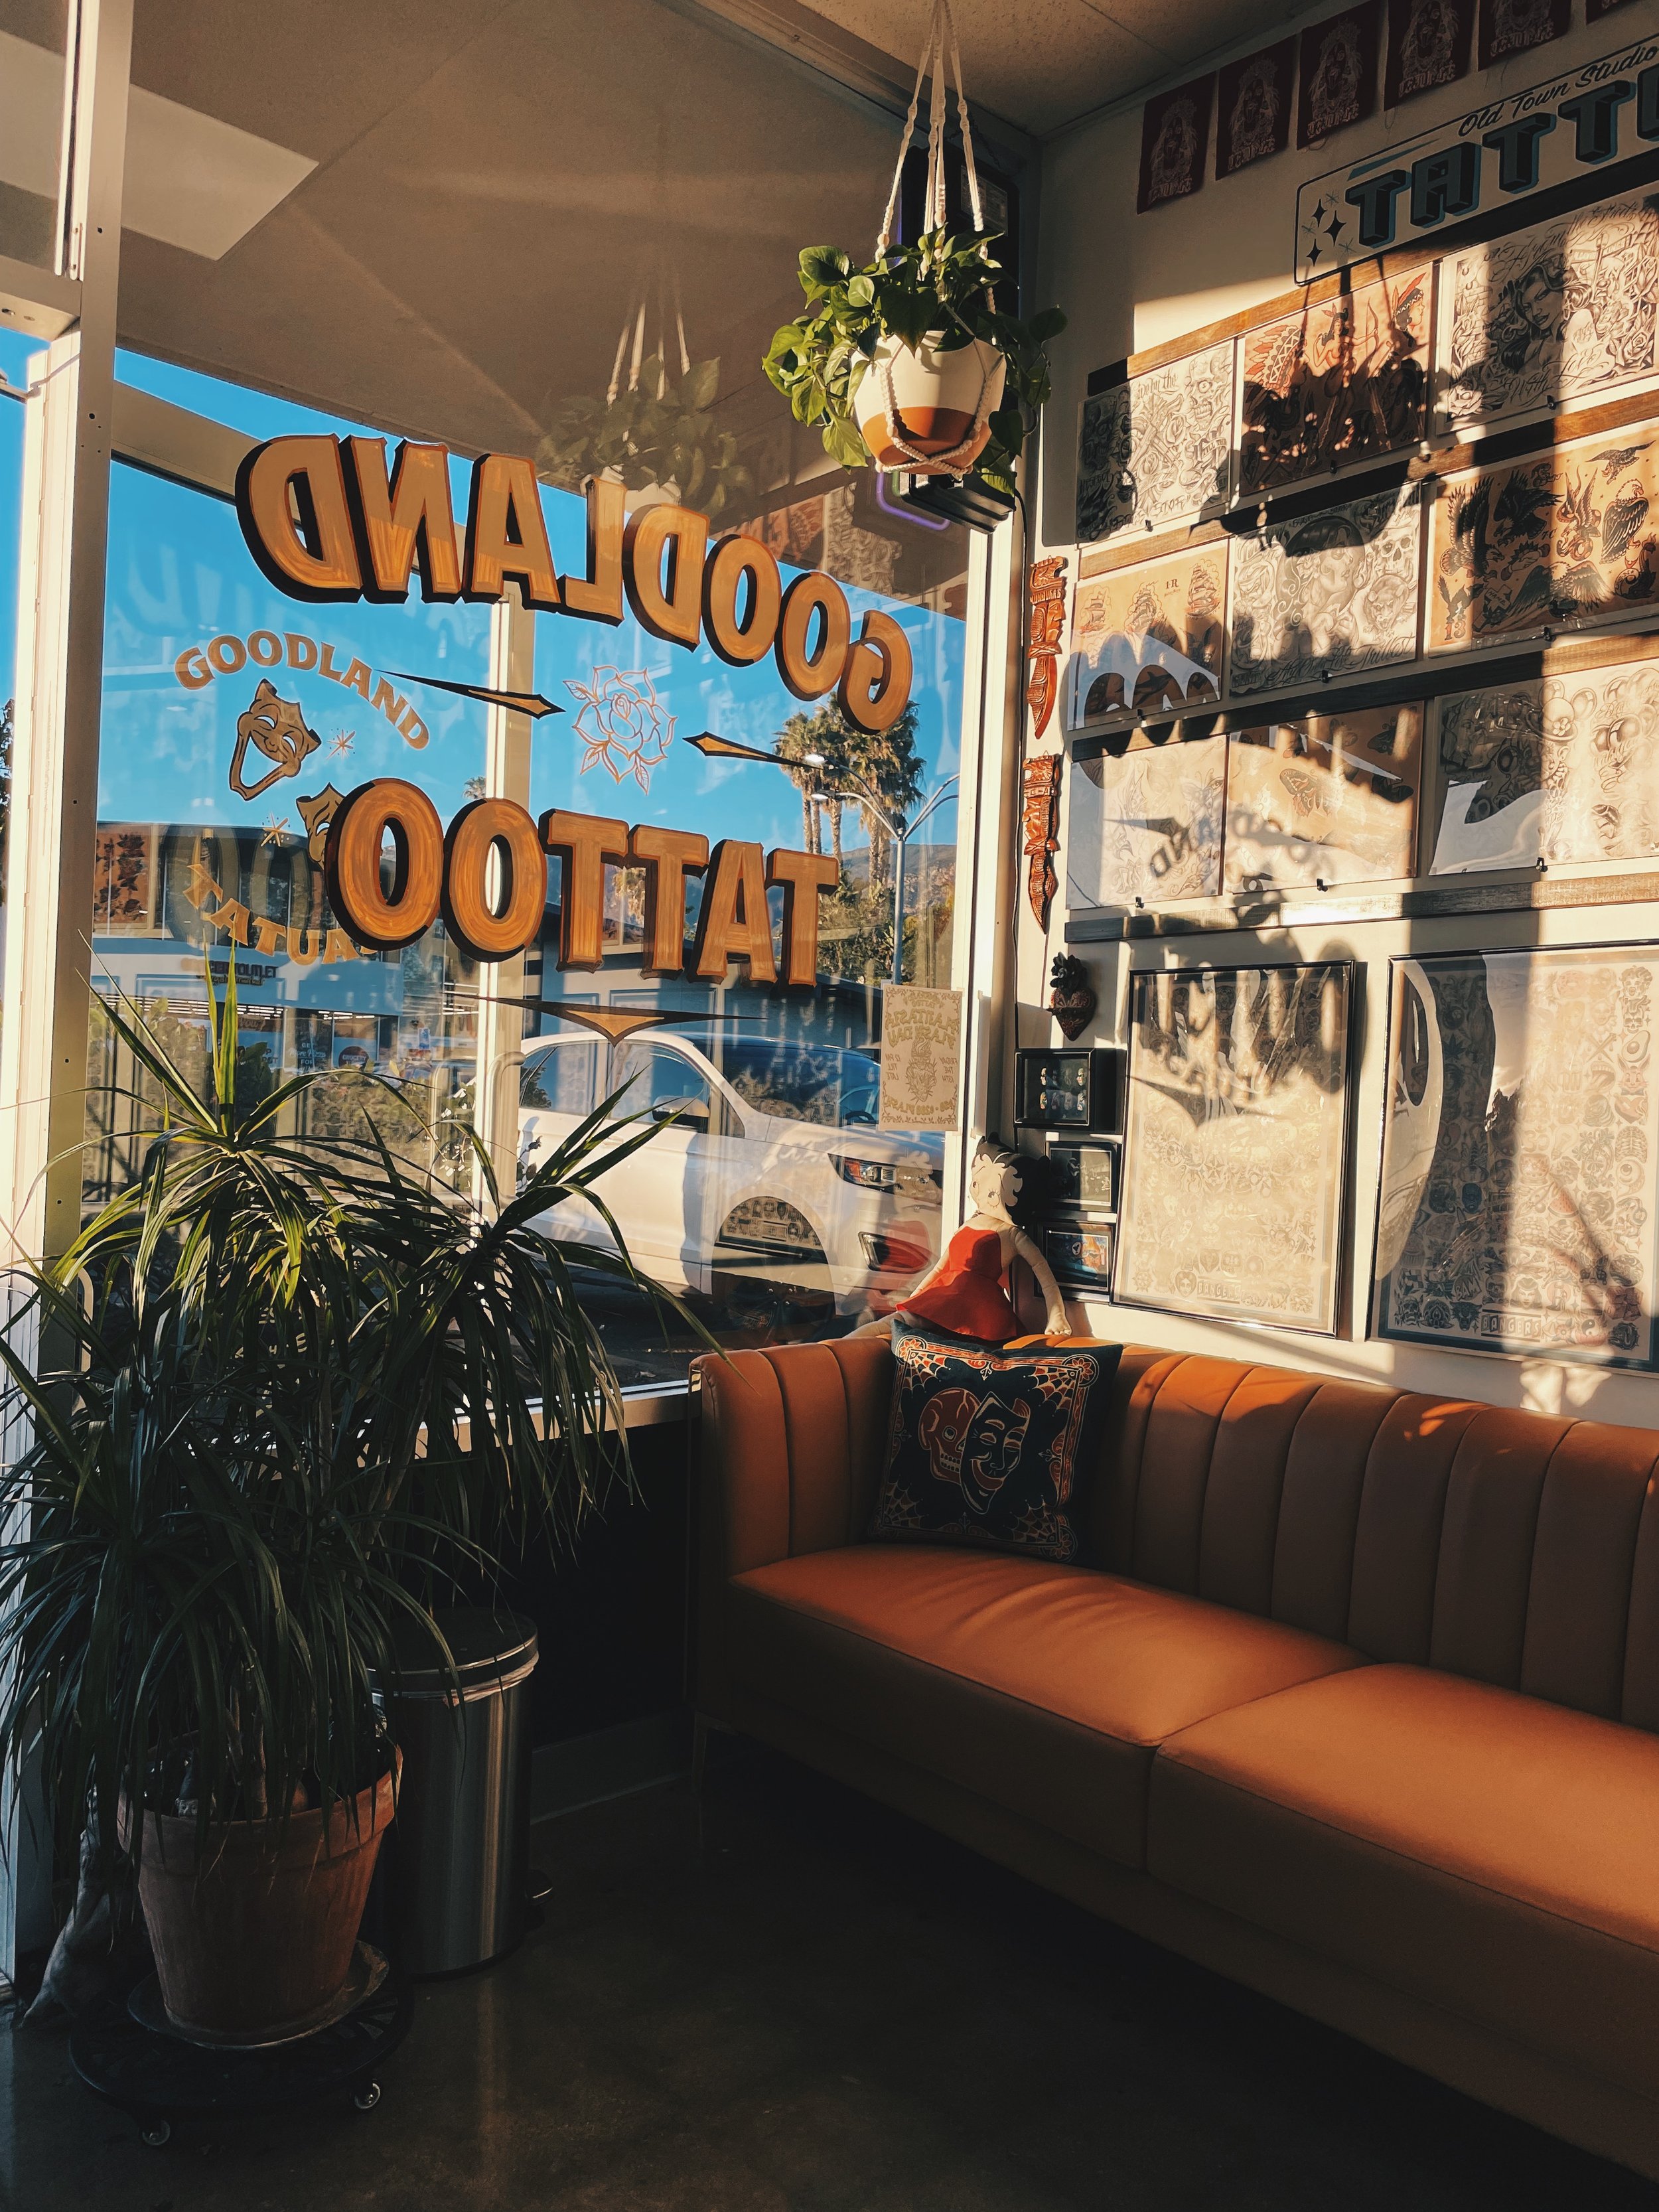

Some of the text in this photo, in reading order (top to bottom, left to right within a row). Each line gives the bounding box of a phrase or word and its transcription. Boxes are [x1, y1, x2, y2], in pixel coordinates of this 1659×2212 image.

[1458, 45, 1659, 137] Old Town Studio
[1488, 590, 1506, 606] NAME
[1444, 616, 1467, 643] 13
[175, 630, 431, 751] GOODLAND
[183, 863, 378, 966] TATUA
[1456, 1280, 1481, 1299] BAM
[1481, 1313, 1542, 1337] BANGERS
